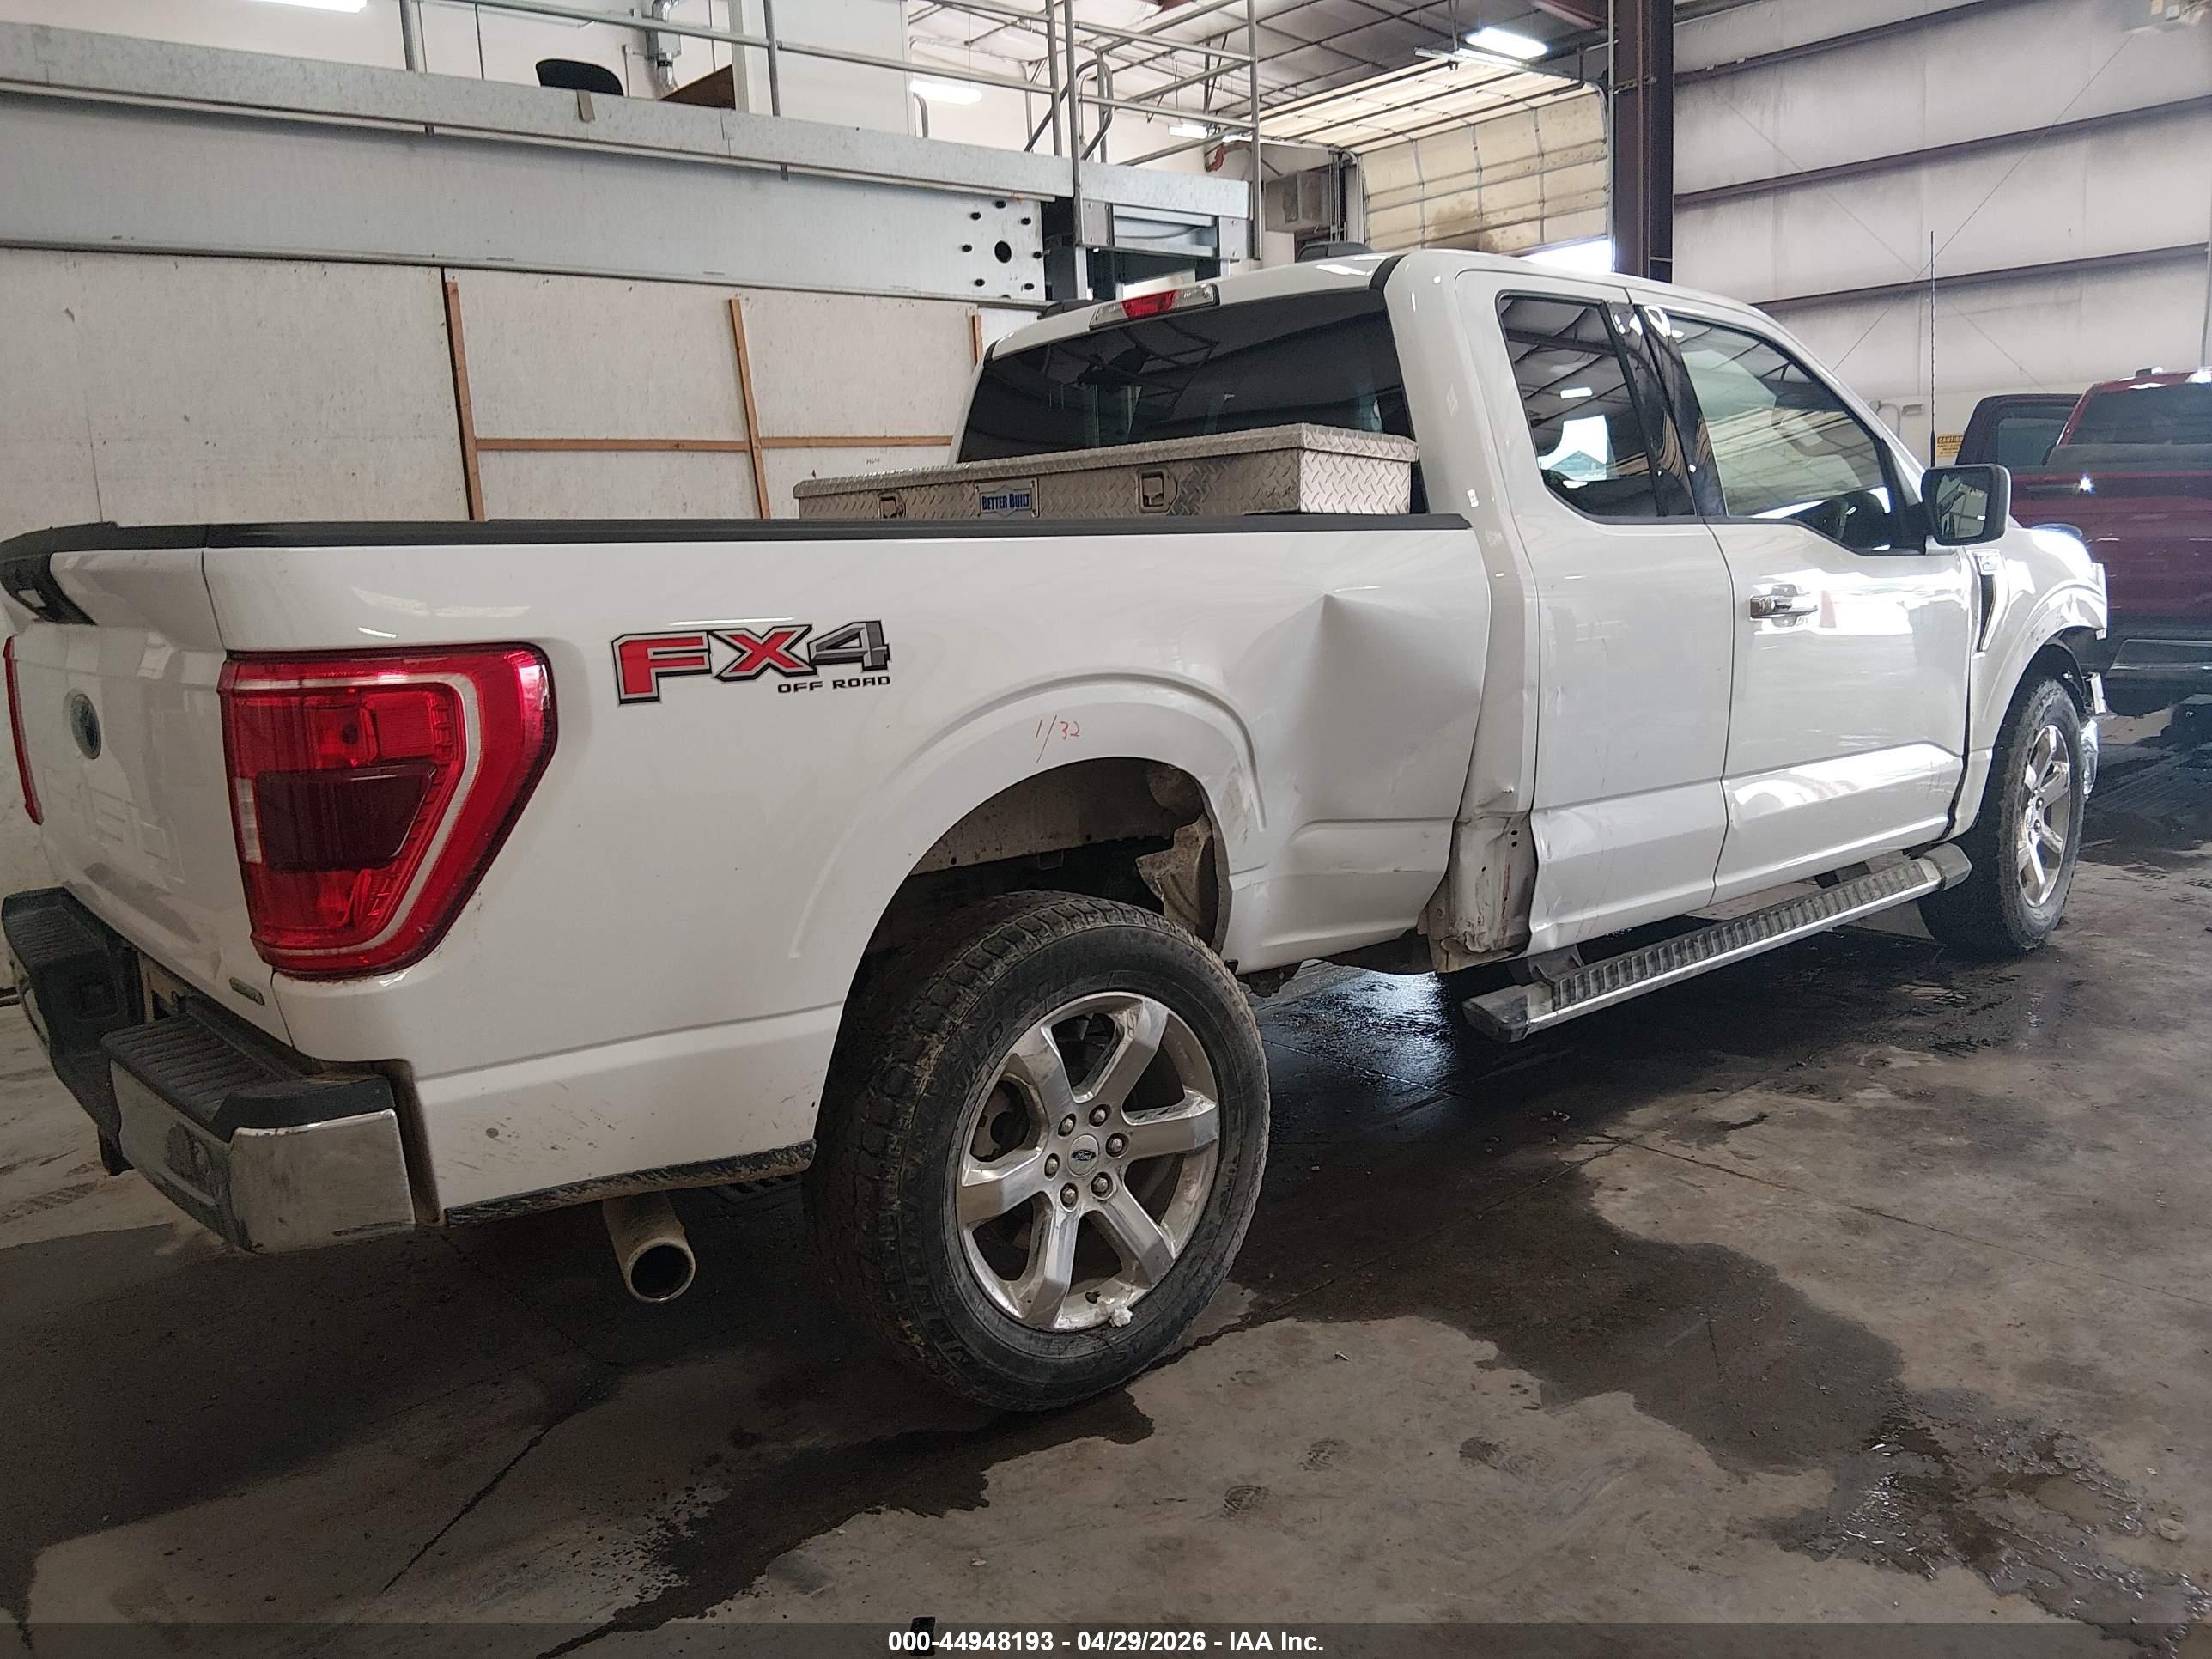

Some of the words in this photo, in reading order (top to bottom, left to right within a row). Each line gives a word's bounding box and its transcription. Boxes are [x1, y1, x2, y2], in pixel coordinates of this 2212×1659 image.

[981, 495, 1008, 510] BETTER
[1009, 493, 1030, 508] BUILT
[611, 619, 890, 706] FX4
[777, 681, 823, 694] OFF
[831, 675, 890, 690] ROAD
